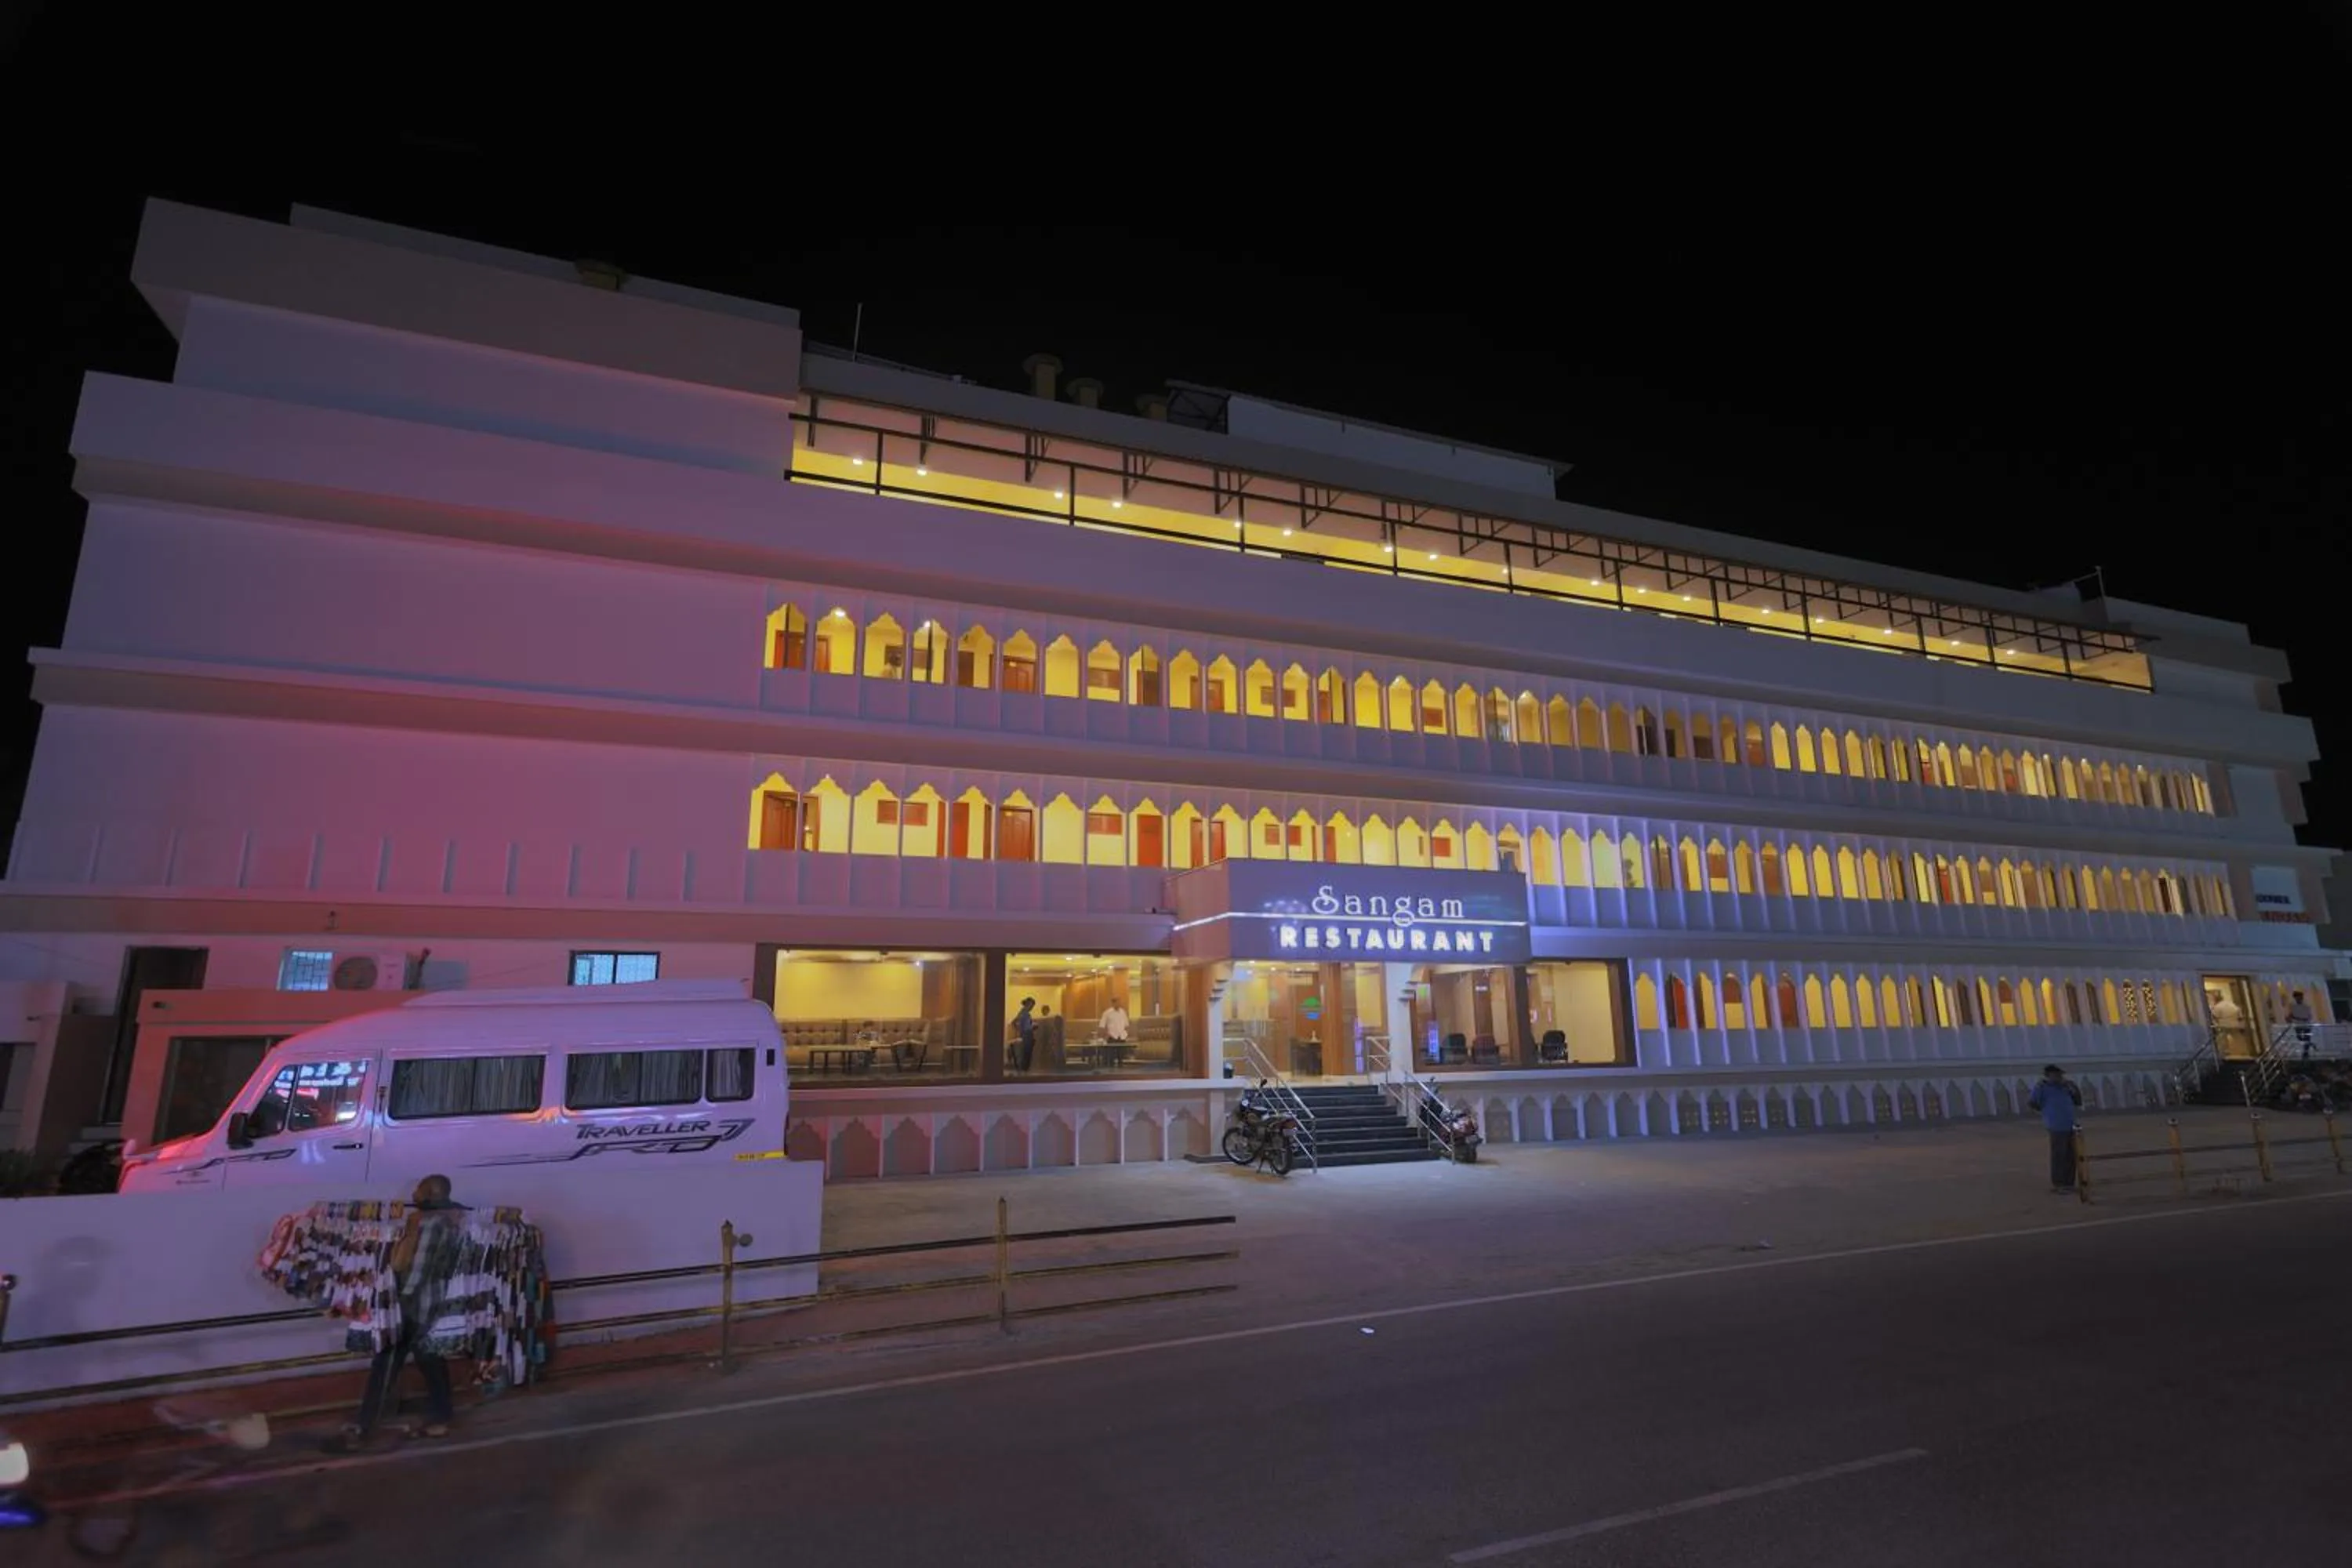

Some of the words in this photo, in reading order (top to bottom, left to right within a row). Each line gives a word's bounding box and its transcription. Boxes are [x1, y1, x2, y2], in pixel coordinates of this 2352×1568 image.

[1312, 885, 1464, 927] Sangam
[1279, 926, 1494, 952] RESTAURANT
[576, 1120, 710, 1139] TRAVELLER
